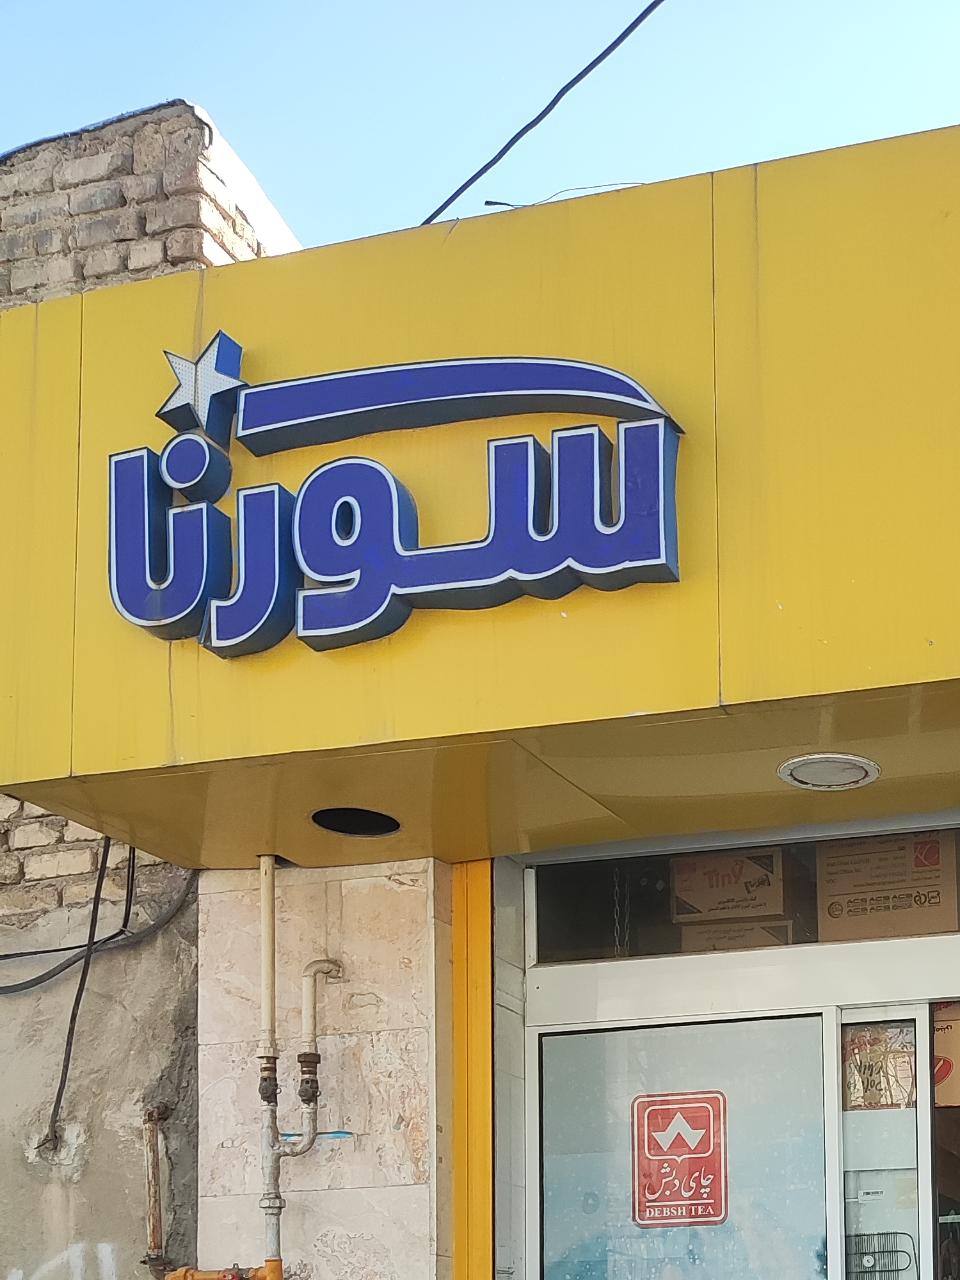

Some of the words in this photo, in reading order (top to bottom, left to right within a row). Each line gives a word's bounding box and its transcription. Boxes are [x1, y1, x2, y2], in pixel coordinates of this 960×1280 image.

[108, 418, 682, 660] سورنا
[645, 1163, 680, 1200] دبش
[681, 1166, 714, 1198] چای
[646, 1206, 686, 1217] DEBSH
[687, 1205, 714, 1216] TEA
